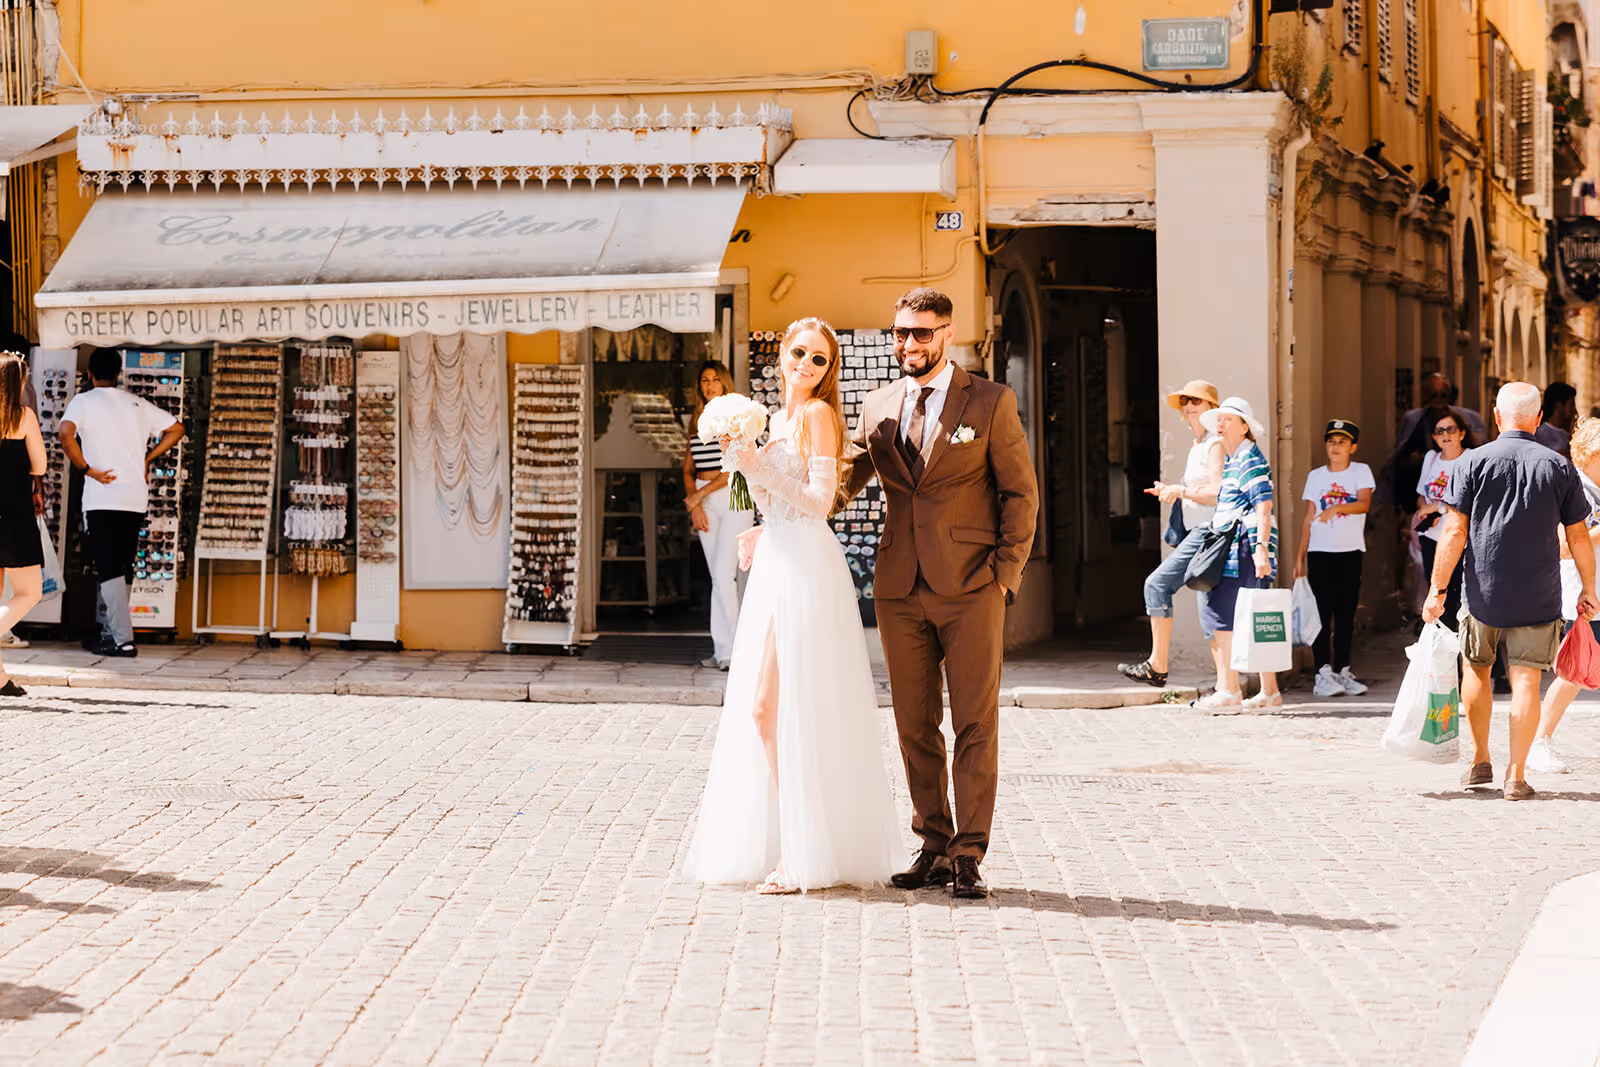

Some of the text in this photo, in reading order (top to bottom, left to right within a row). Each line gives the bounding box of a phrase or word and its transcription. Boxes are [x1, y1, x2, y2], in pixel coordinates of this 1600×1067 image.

[158, 209, 602, 247] Cosmopolitan
[937, 212, 961, 230] 48
[64, 310, 136, 337] GREEK
[146, 306, 246, 335] POPULAR
[255, 305, 297, 333] ART
[304, 301, 430, 331] SOUVENIRS
[454, 295, 580, 326] JEWELLERY
[606, 291, 702, 321] LEATHER
[1255, 624, 1283, 632] SPENCER
